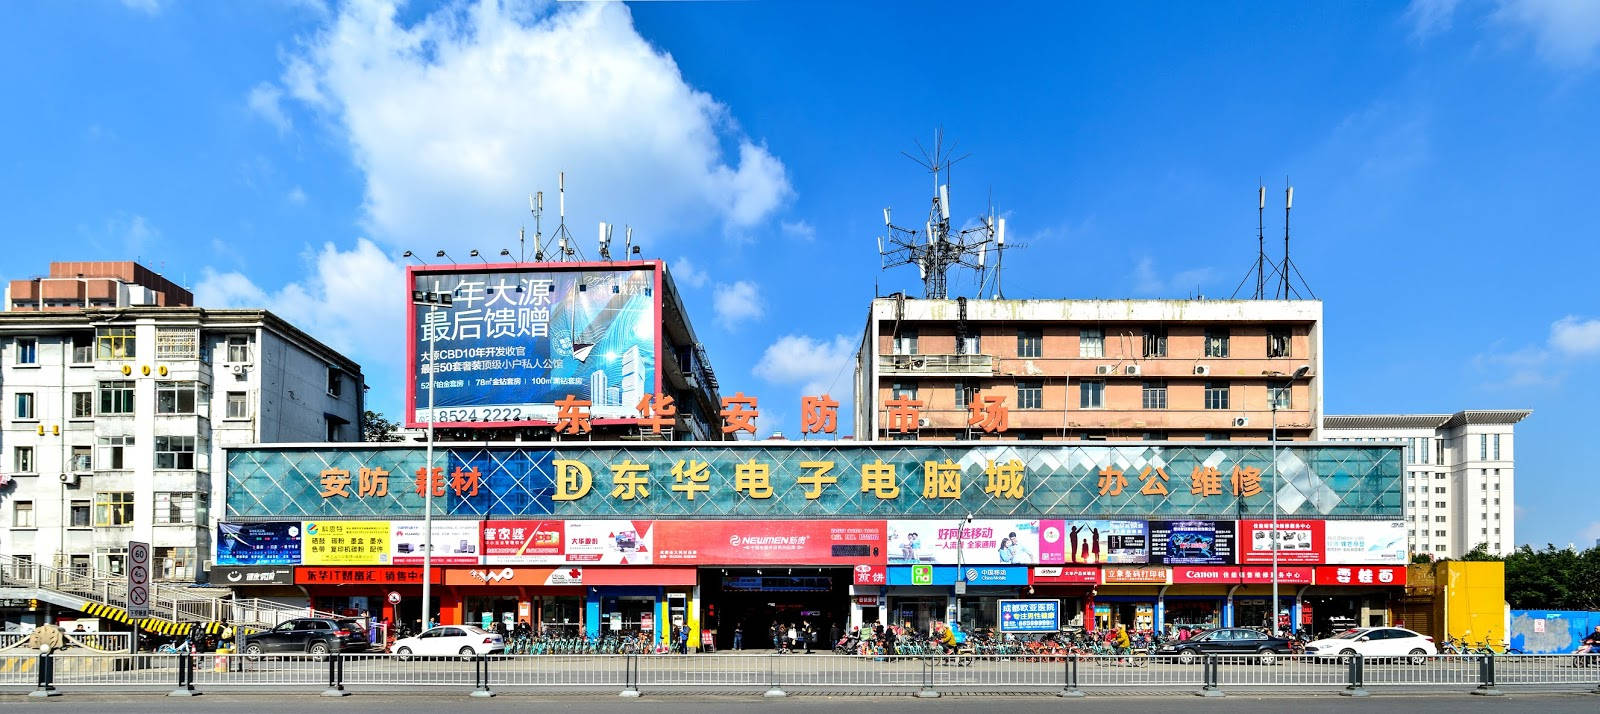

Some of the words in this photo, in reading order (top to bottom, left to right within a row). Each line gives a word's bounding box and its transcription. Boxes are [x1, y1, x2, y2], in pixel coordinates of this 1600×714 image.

[420, 307, 551, 342] 最后馈赠
[439, 409, 477, 422] 8524
[483, 408, 522, 421] 2222
[554, 392, 1009, 435] 东华安防市场
[319, 467, 389, 498] 安防
[415, 466, 482, 498] 耗材
[611, 458, 1024, 501] 东华电子电脑城
[1097, 466, 1169, 497] 办公
[1191, 465, 1263, 497] 维修
[484, 527, 525, 540] 管家婆
[937, 528, 993, 540] 好网选移动
[742, 536, 789, 545] NEWMEN
[967, 540, 997, 549] 全家通用
[857, 572, 884, 582] 煎饼
[1186, 570, 1219, 579] Canon
[1223, 571, 1300, 579] 佳能销售维修务中心
[1003, 603, 1055, 612] 成都欧亚医院
